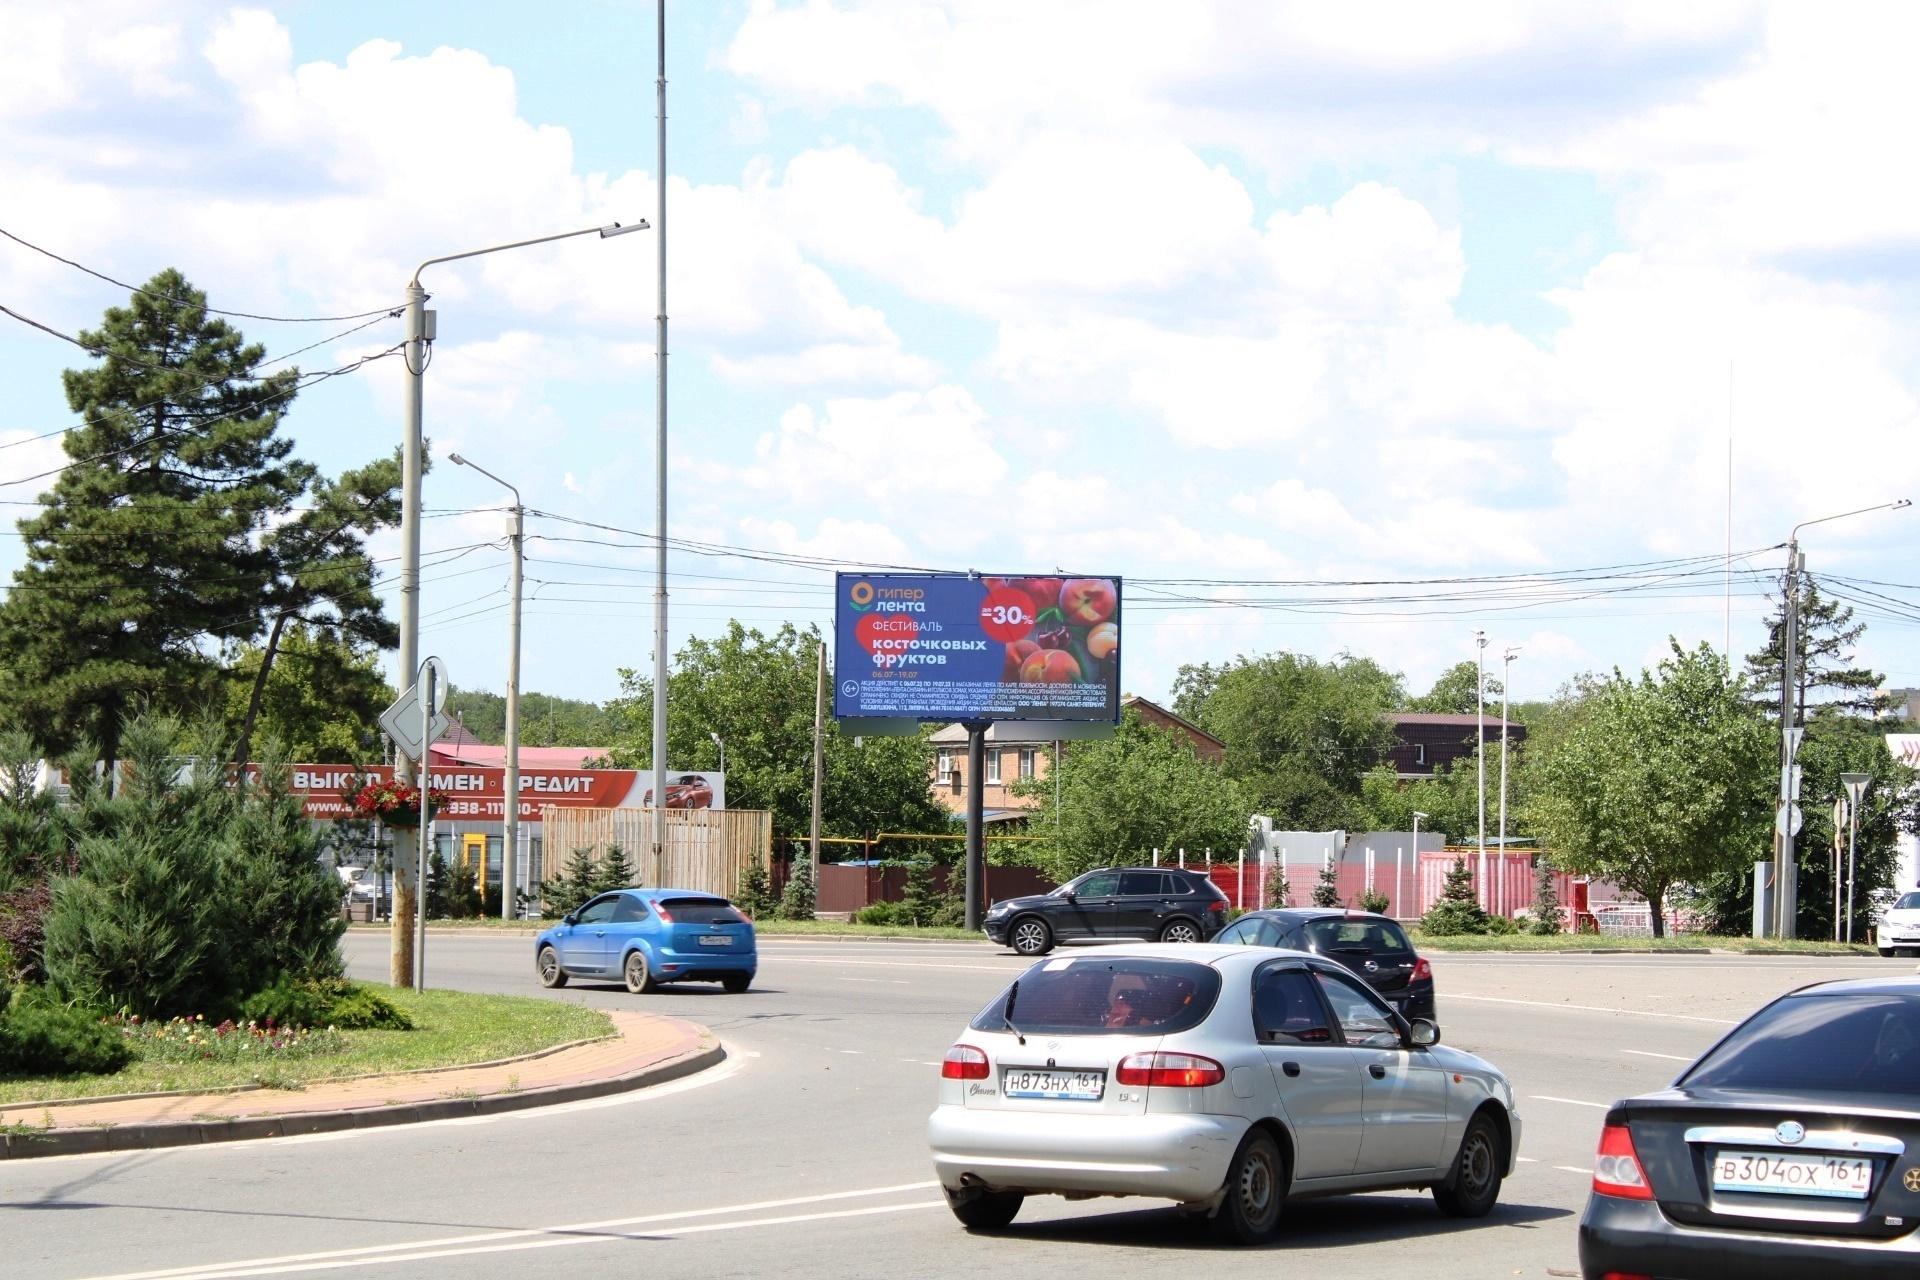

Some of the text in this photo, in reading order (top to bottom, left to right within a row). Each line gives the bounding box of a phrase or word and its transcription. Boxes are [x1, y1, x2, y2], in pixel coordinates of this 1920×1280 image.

[878, 588, 924, 601] гипер
[876, 601, 926, 612] лента
[872, 621, 943, 632] ФЕСТИВАЛЬ
[872, 639, 987, 651] косточковых
[872, 650, 947, 668] фруктов
[845, 684, 857, 693] 6+
[417, 773, 484, 791] БМЕН
[503, 775, 594, 793] РЕДИТ
[1010, 1073, 1097, 1092] Н873НХ 161
[1723, 1156, 1864, 1185] В304ОХ 161
